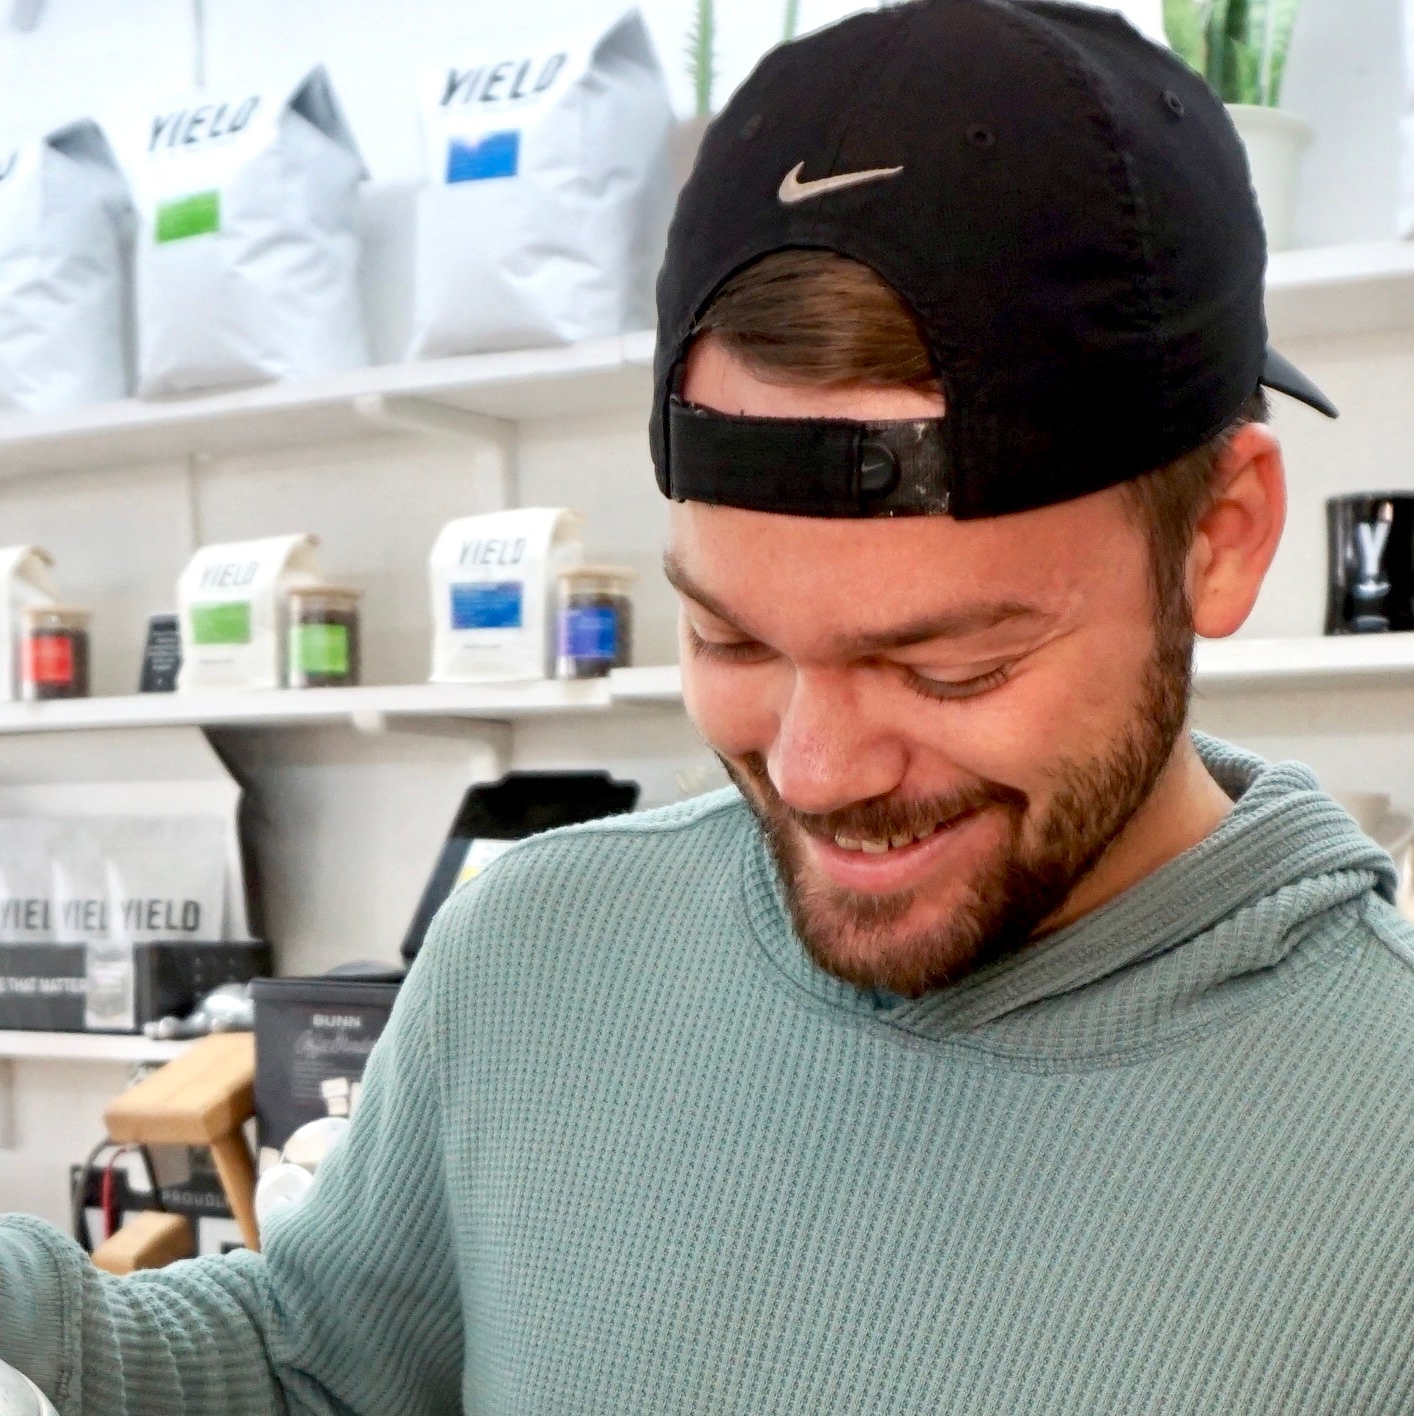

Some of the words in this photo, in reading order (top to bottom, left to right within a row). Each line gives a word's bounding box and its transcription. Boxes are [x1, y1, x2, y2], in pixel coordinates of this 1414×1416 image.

[439, 52, 567, 106] YIELD
[148, 97, 260, 152] YIELD
[458, 537, 526, 566] YIELD
[200, 561, 258, 588] YIELD
[122, 899, 201, 932] YIELD
[7, 977, 36, 993] THAT
[312, 1013, 362, 1028] BUNN
